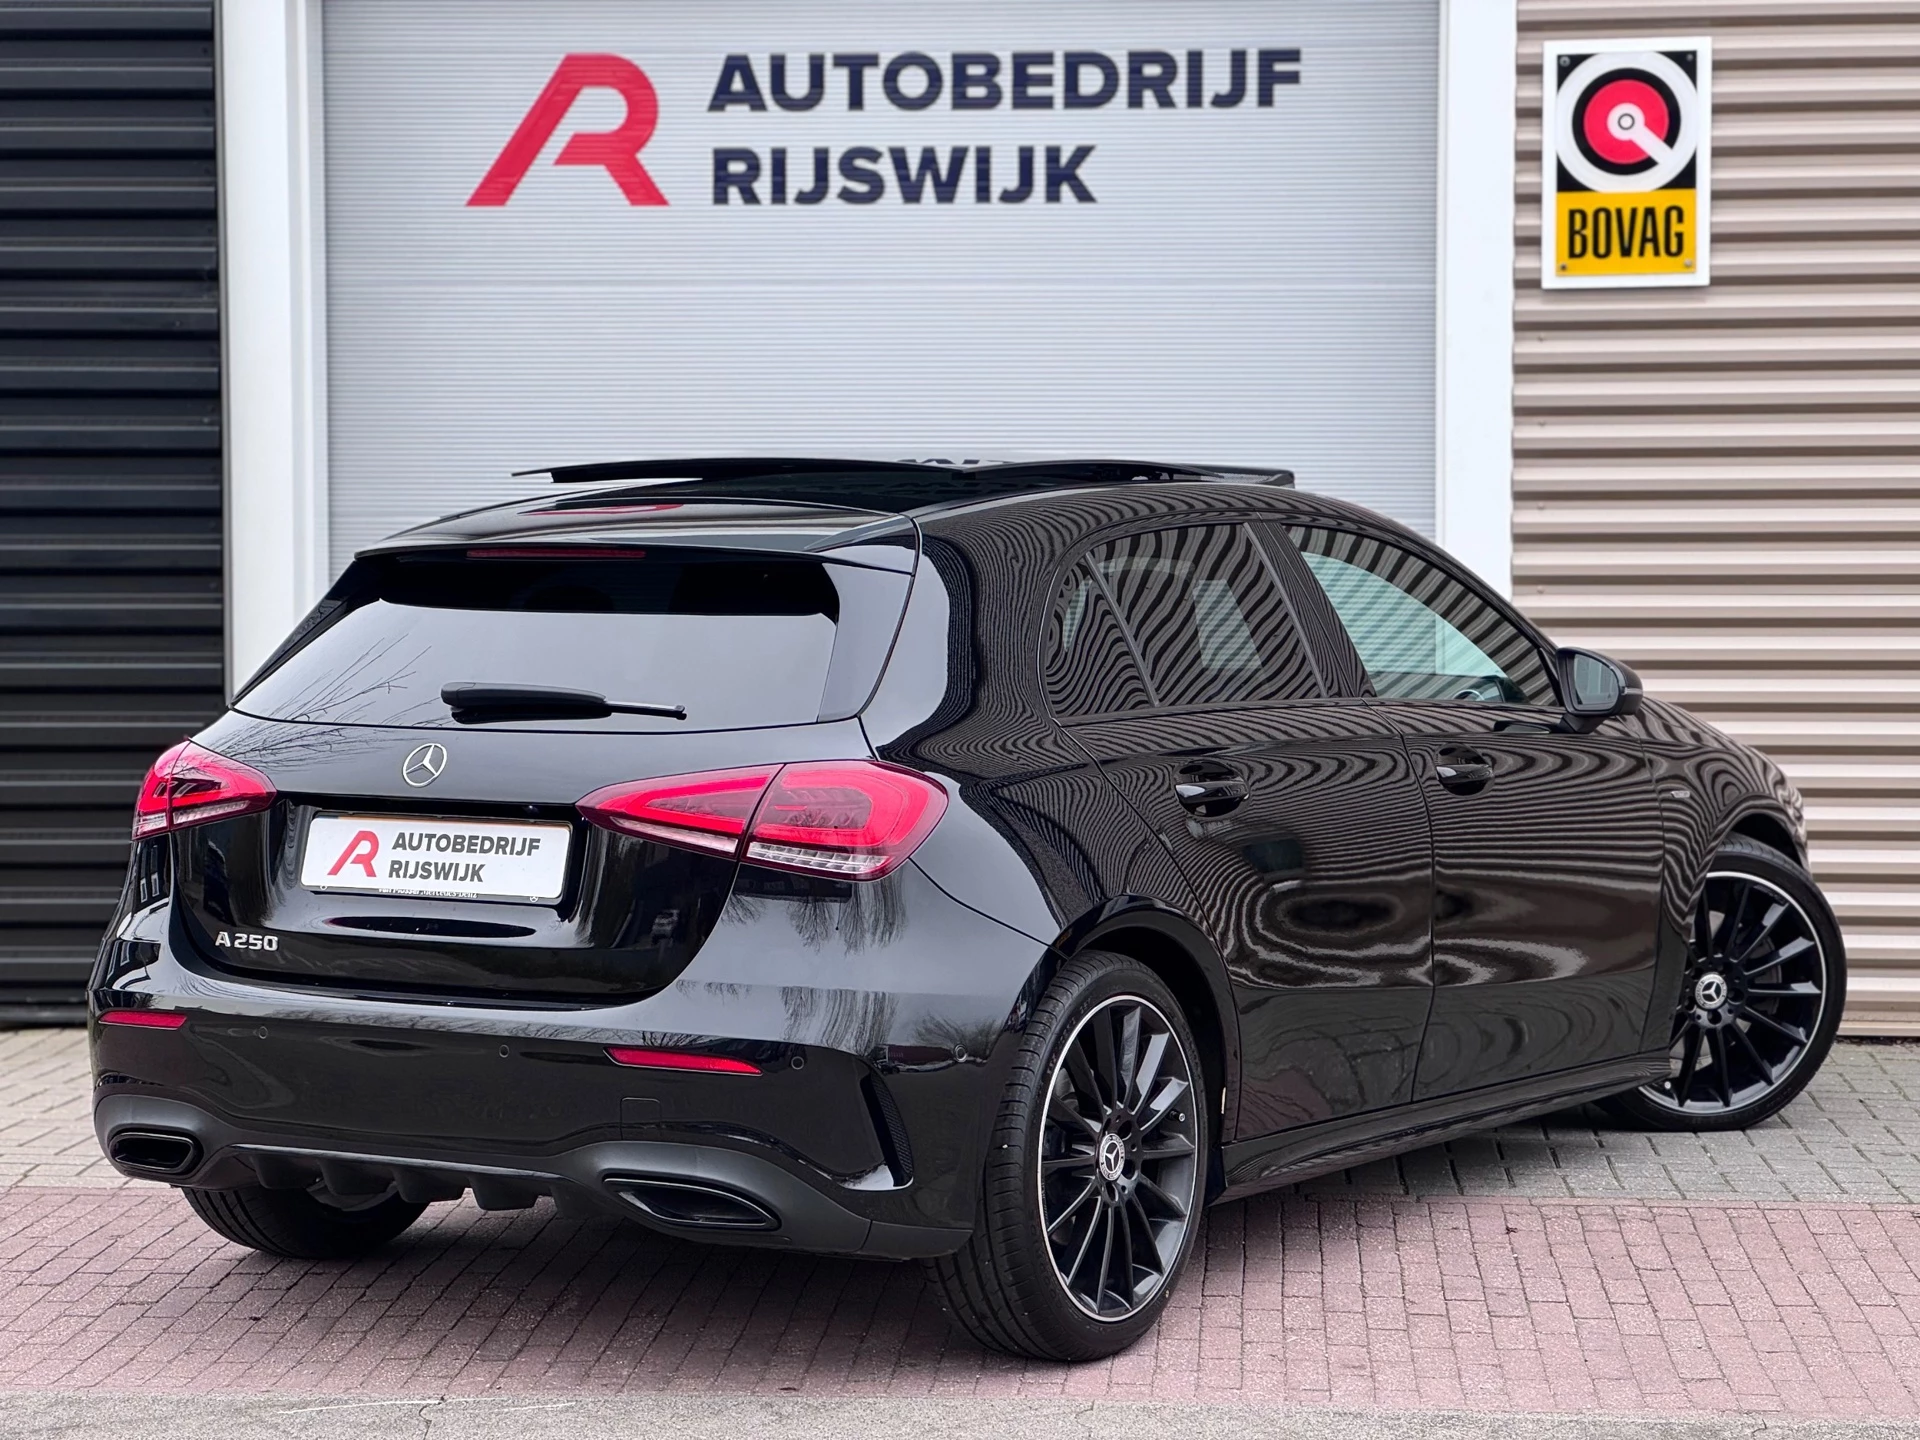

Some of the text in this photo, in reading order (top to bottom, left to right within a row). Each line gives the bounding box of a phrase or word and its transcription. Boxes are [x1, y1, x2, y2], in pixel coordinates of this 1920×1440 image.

[707, 48, 1302, 112] AUTOBEDRIJF
[712, 145, 1097, 205] RIJSWIJK
[1567, 205, 1685, 260] BOVAG
[391, 832, 541, 857] AUTOBEDRIJF
[388, 859, 485, 883] RIJSWIJK
[214, 931, 279, 951] A 250
